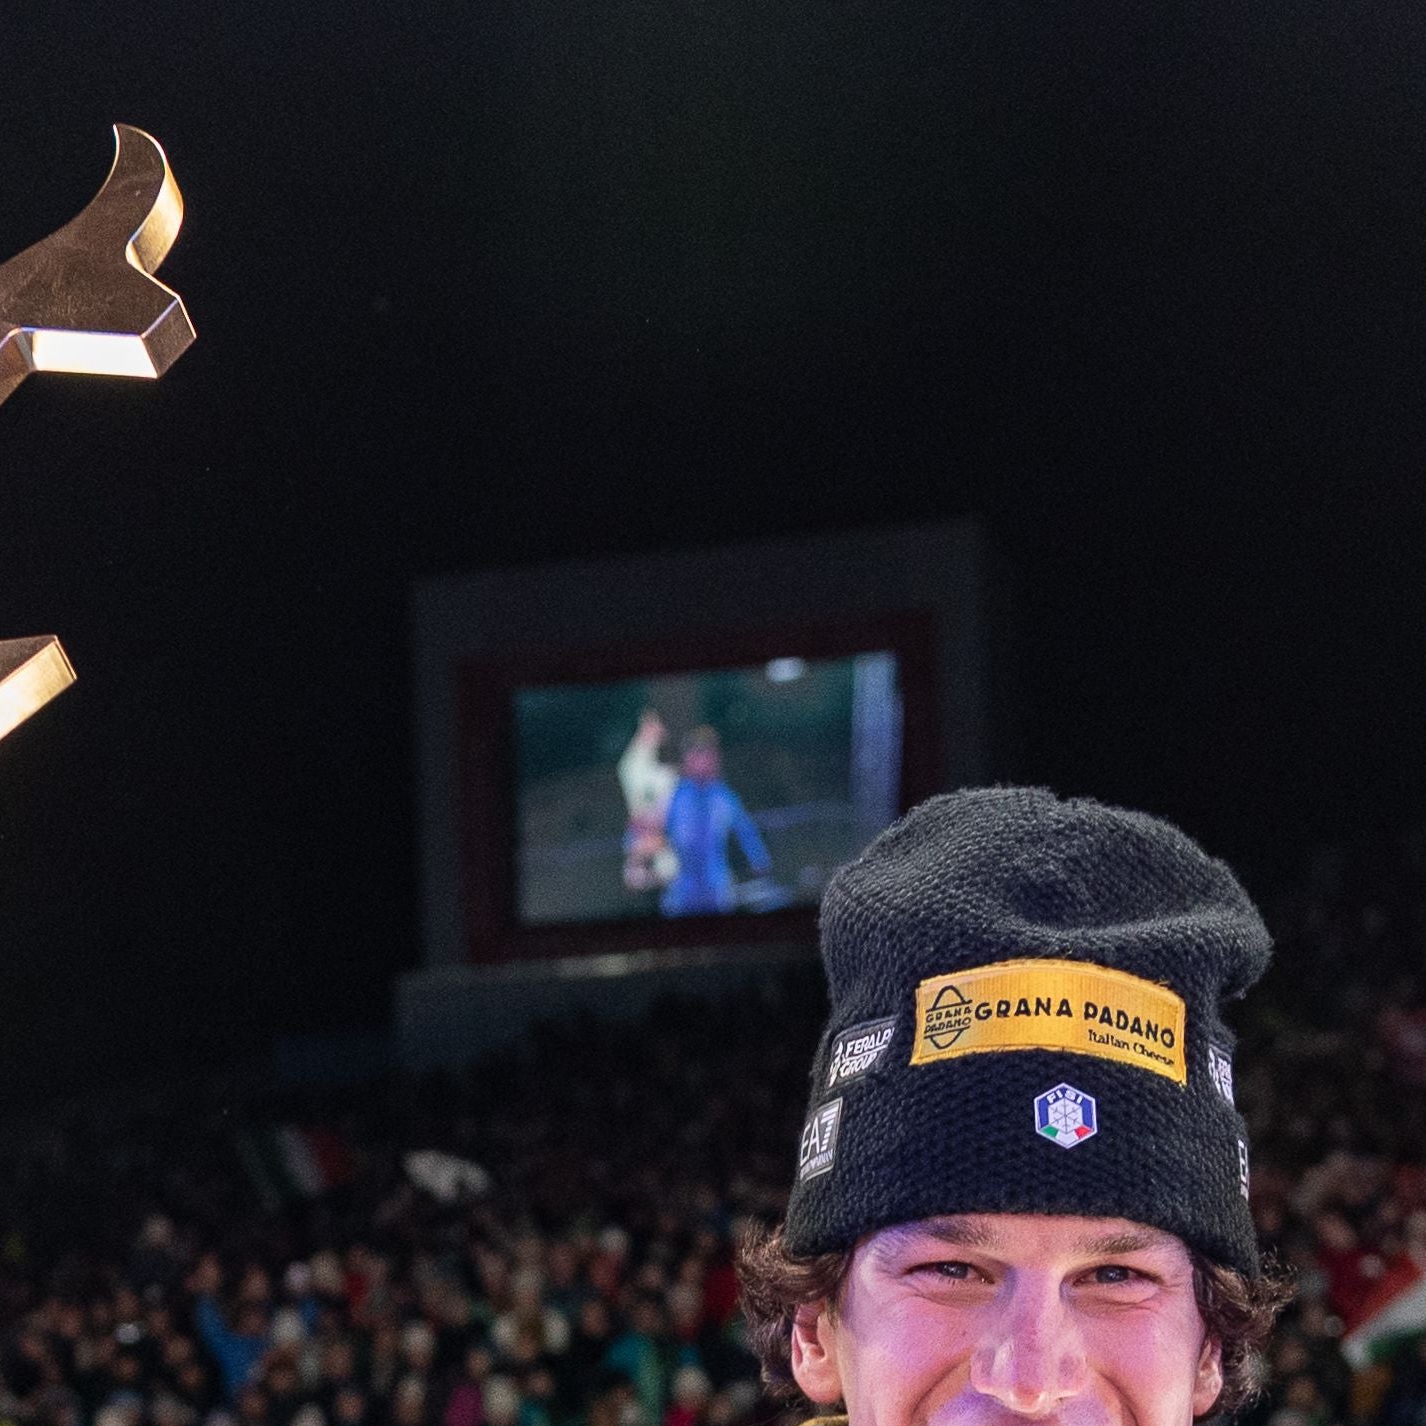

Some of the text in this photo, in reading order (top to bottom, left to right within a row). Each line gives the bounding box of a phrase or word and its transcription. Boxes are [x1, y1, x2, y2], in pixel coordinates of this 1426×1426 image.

[924, 1016, 971, 1034] PADANO
[926, 1006, 972, 1022] GRANA
[975, 997, 1175, 1048] GRANA PADANO
[1088, 1029, 1175, 1067] Italian Cheese
[839, 1052, 878, 1077] GROUP
[1046, 1089, 1083, 1104] FISI
[800, 1106, 838, 1165] EA7
